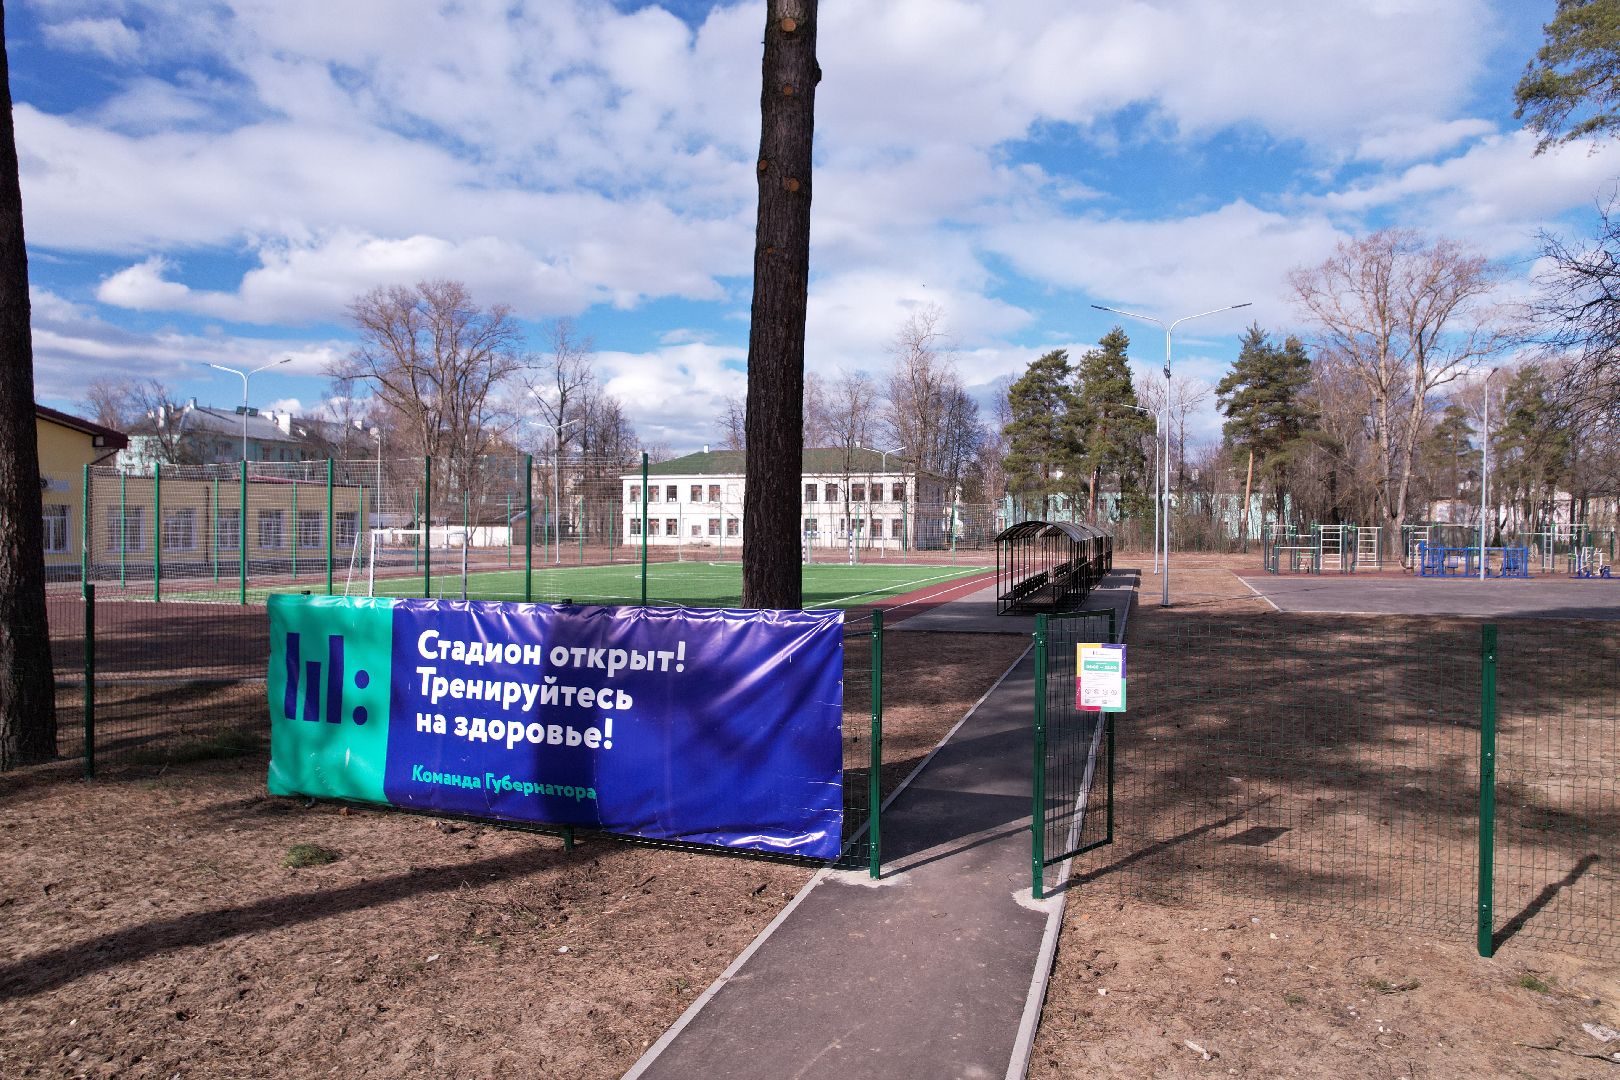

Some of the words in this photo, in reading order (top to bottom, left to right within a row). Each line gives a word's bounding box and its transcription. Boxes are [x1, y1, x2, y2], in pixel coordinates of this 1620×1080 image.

[417, 629, 541, 666] Стадион
[550, 641, 686, 677] открыт!
[416, 666, 633, 711] Тренируйтесь
[416, 712, 447, 735] на
[454, 715, 613, 749] здоровье!
[411, 764, 481, 789] Команда
[485, 772, 597, 802] Губернатора
